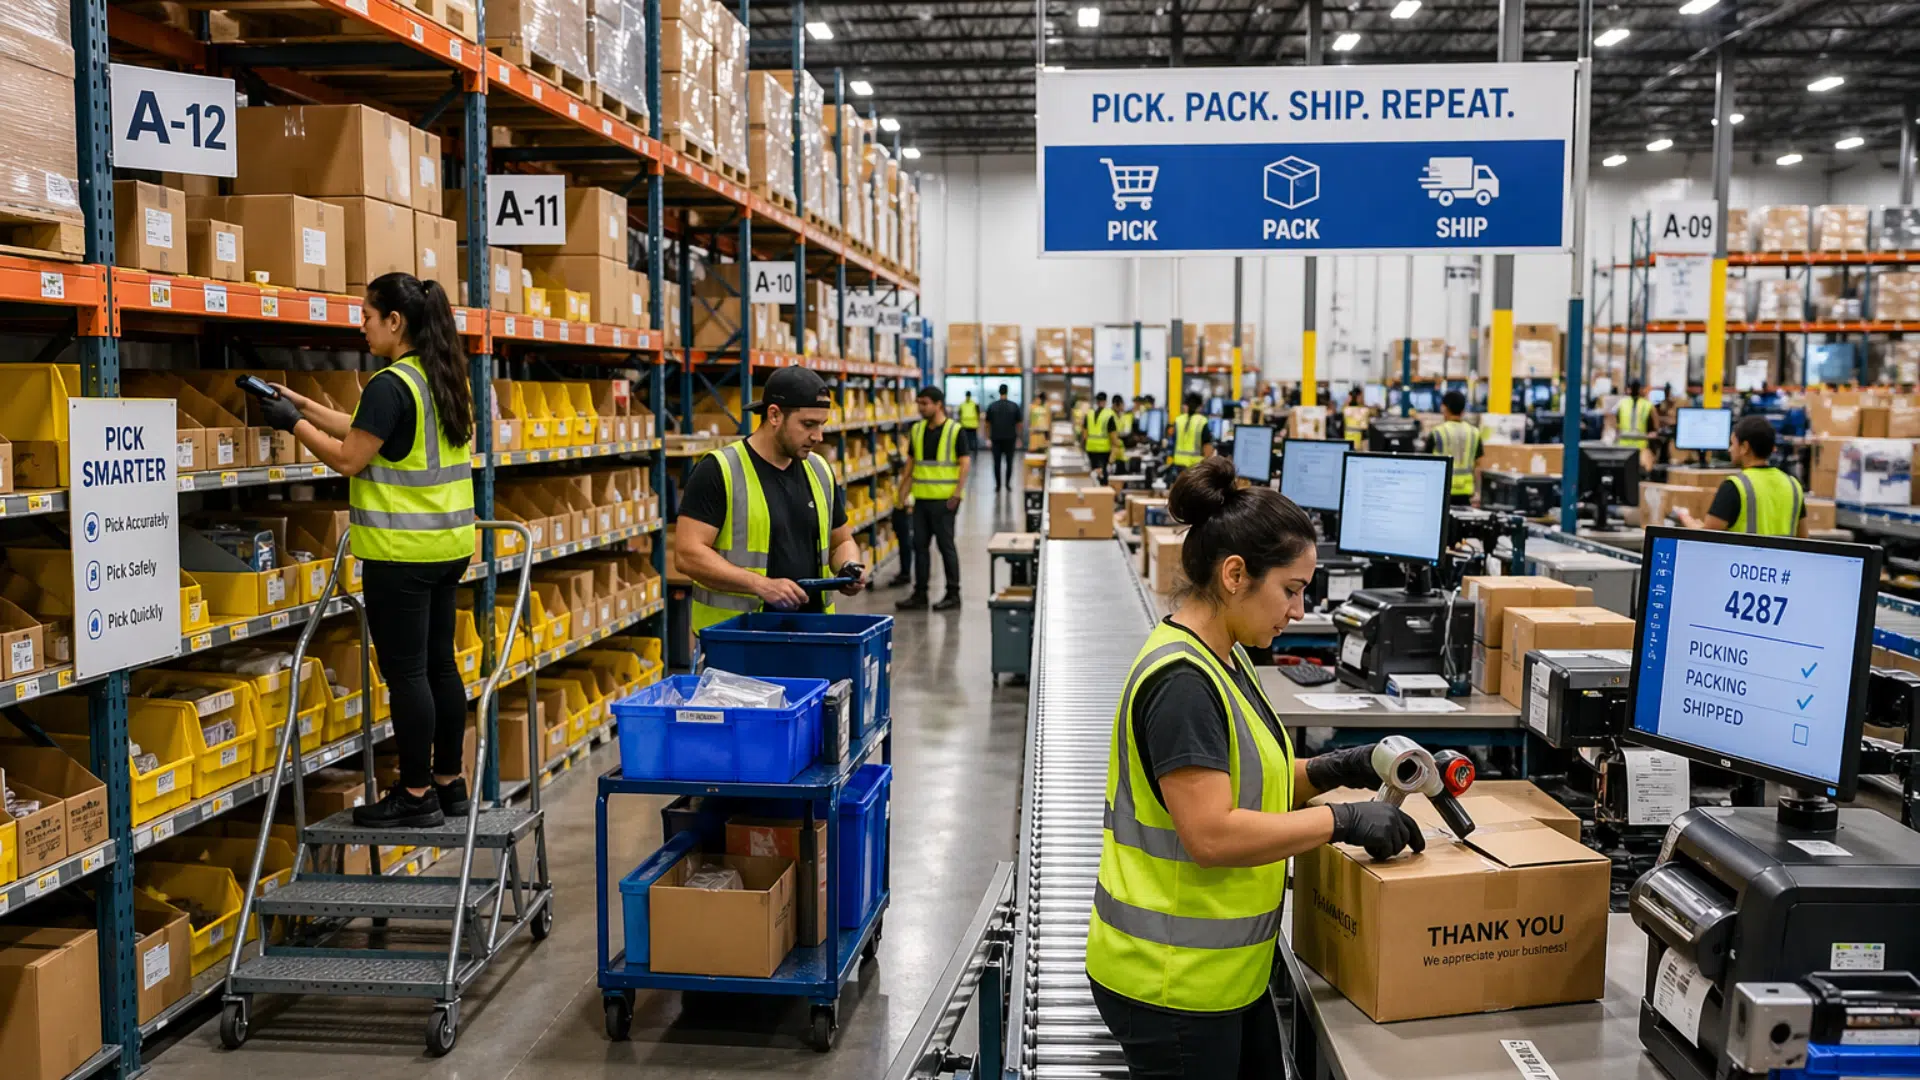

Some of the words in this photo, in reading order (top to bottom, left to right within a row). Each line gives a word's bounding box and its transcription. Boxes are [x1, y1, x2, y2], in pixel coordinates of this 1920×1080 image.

[1092, 92, 1175, 123] PICK.
[1185, 91, 1279, 122] PACK.
[1289, 89, 1370, 121] SHIP.
[1381, 87, 1515, 120] REPEAT.
[125, 89, 227, 151] A-12
[495, 189, 559, 227] A-11
[1107, 219, 1159, 242] PICK
[1262, 218, 1321, 241] PACK
[1435, 216, 1489, 239] SHIP
[1663, 213, 1712, 239] A-09
[755, 270, 793, 294] A-10
[105, 425, 145, 452] PICK
[82, 457, 167, 488] SMARTER
[104, 516, 125, 533] Pick
[125, 511, 170, 532] Accurately
[106, 562, 127, 581] Pick
[128, 559, 157, 578] Safely
[1729, 562, 1777, 584] ORDER
[1780, 568, 1792, 586] #
[108, 610, 129, 629] Pick
[129, 603, 164, 626] Quickly
[1724, 590, 1789, 627] 4287
[1688, 639, 1749, 667] PICKING
[1685, 668, 1747, 697] PACKING
[1682, 696, 1744, 727] SHIPPED
[1427, 919, 1510, 948] THANK
[1515, 914, 1565, 938] YOU
[1423, 955, 1441, 967] We
[1442, 950, 1495, 967] appreciate
[1497, 948, 1521, 962] your
[1521, 941, 1568, 957] business!
